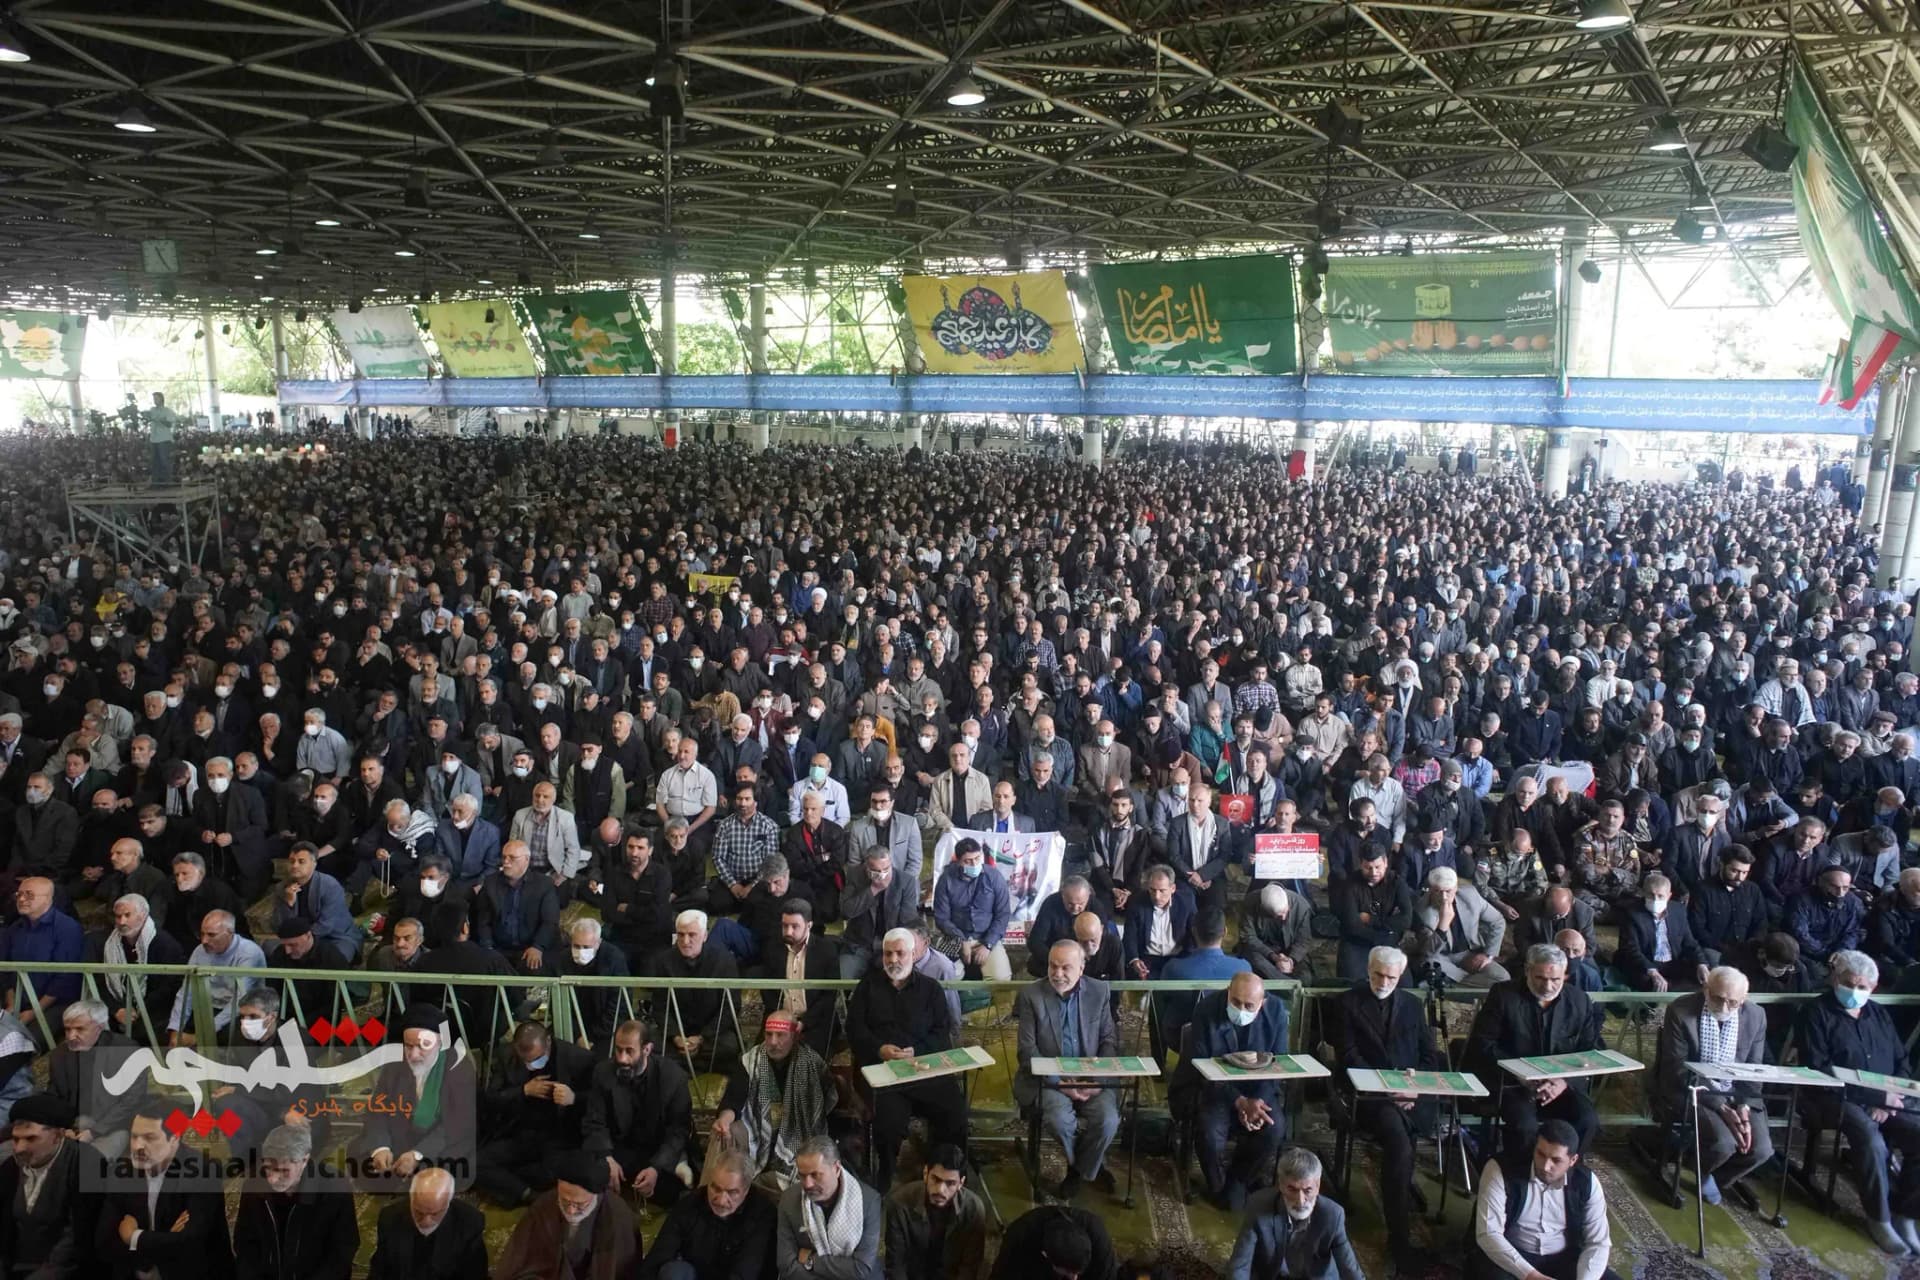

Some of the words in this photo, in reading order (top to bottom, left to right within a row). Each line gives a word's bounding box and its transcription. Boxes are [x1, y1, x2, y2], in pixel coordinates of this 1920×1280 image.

[1199, 282, 1223, 344] یا
[936, 315, 980, 346] جمعه
[973, 317, 1012, 349] عید
[1004, 316, 1042, 349] نماز
